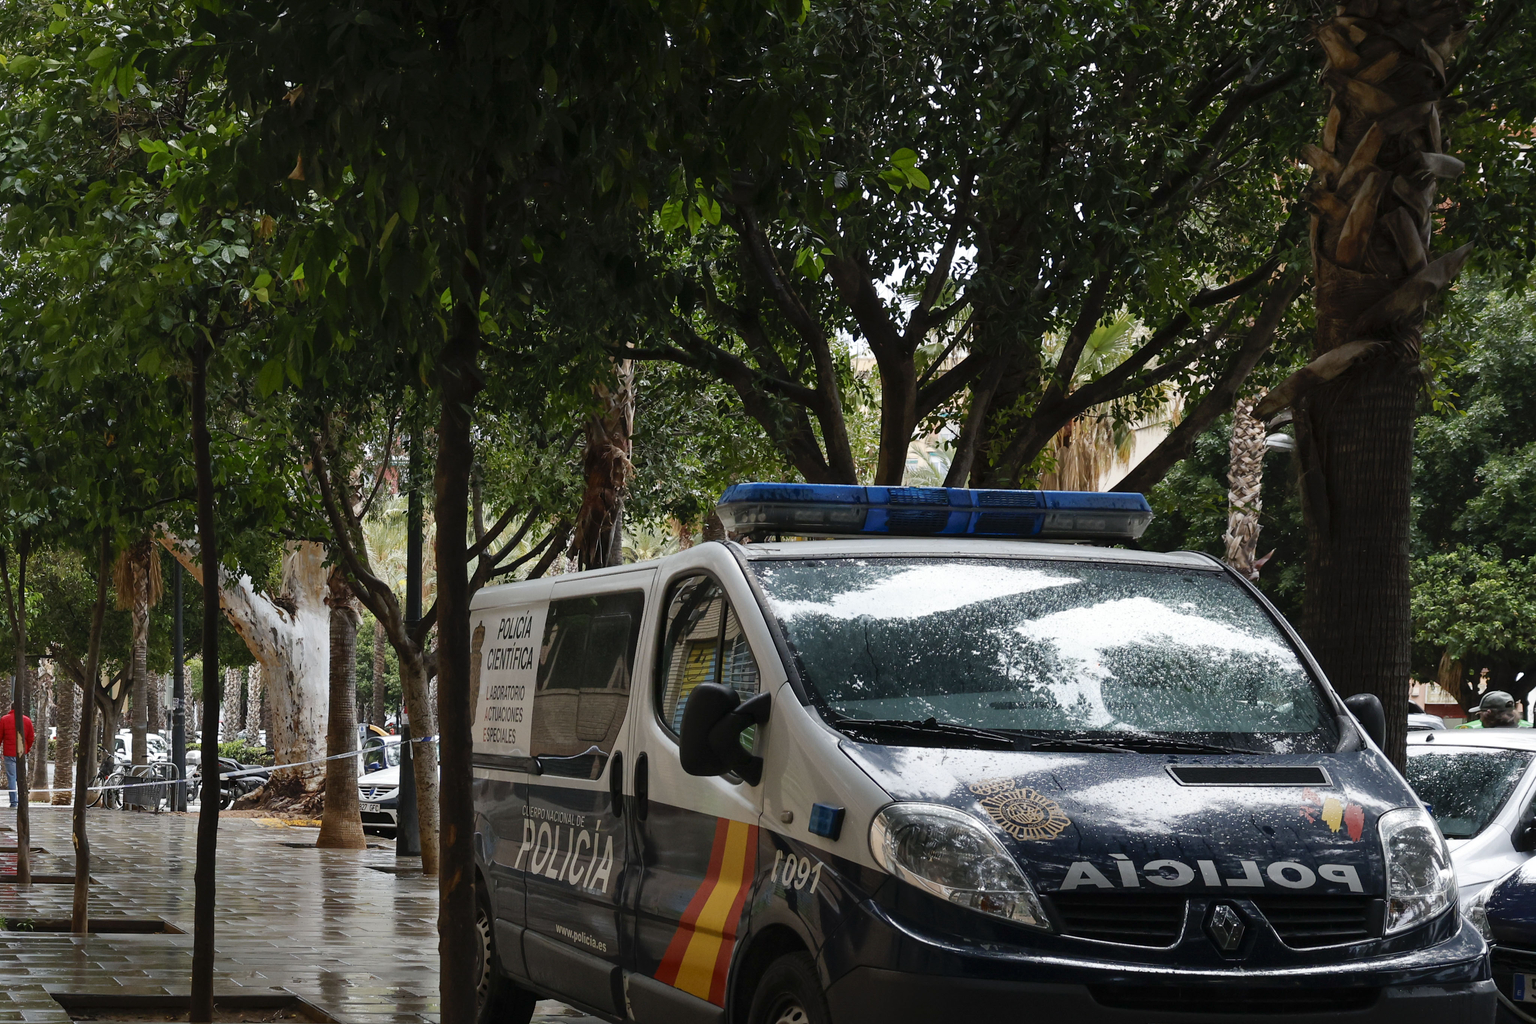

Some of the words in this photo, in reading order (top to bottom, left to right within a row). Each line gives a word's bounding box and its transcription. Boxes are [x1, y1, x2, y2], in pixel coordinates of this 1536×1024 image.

[497, 610, 533, 640] POLICÍA
[487, 643, 534, 670] CIENTÍFICA
[486, 685, 525, 701] LABORATORIO
[484, 707, 523, 723] ACTUACIONES
[483, 727, 516, 744] ESPECIALES
[546, 809, 575, 825] NACIONAL
[576, 814, 585, 827] DE
[514, 818, 614, 894] POLICÍA
[555, 923, 607, 953] www.policia.es
